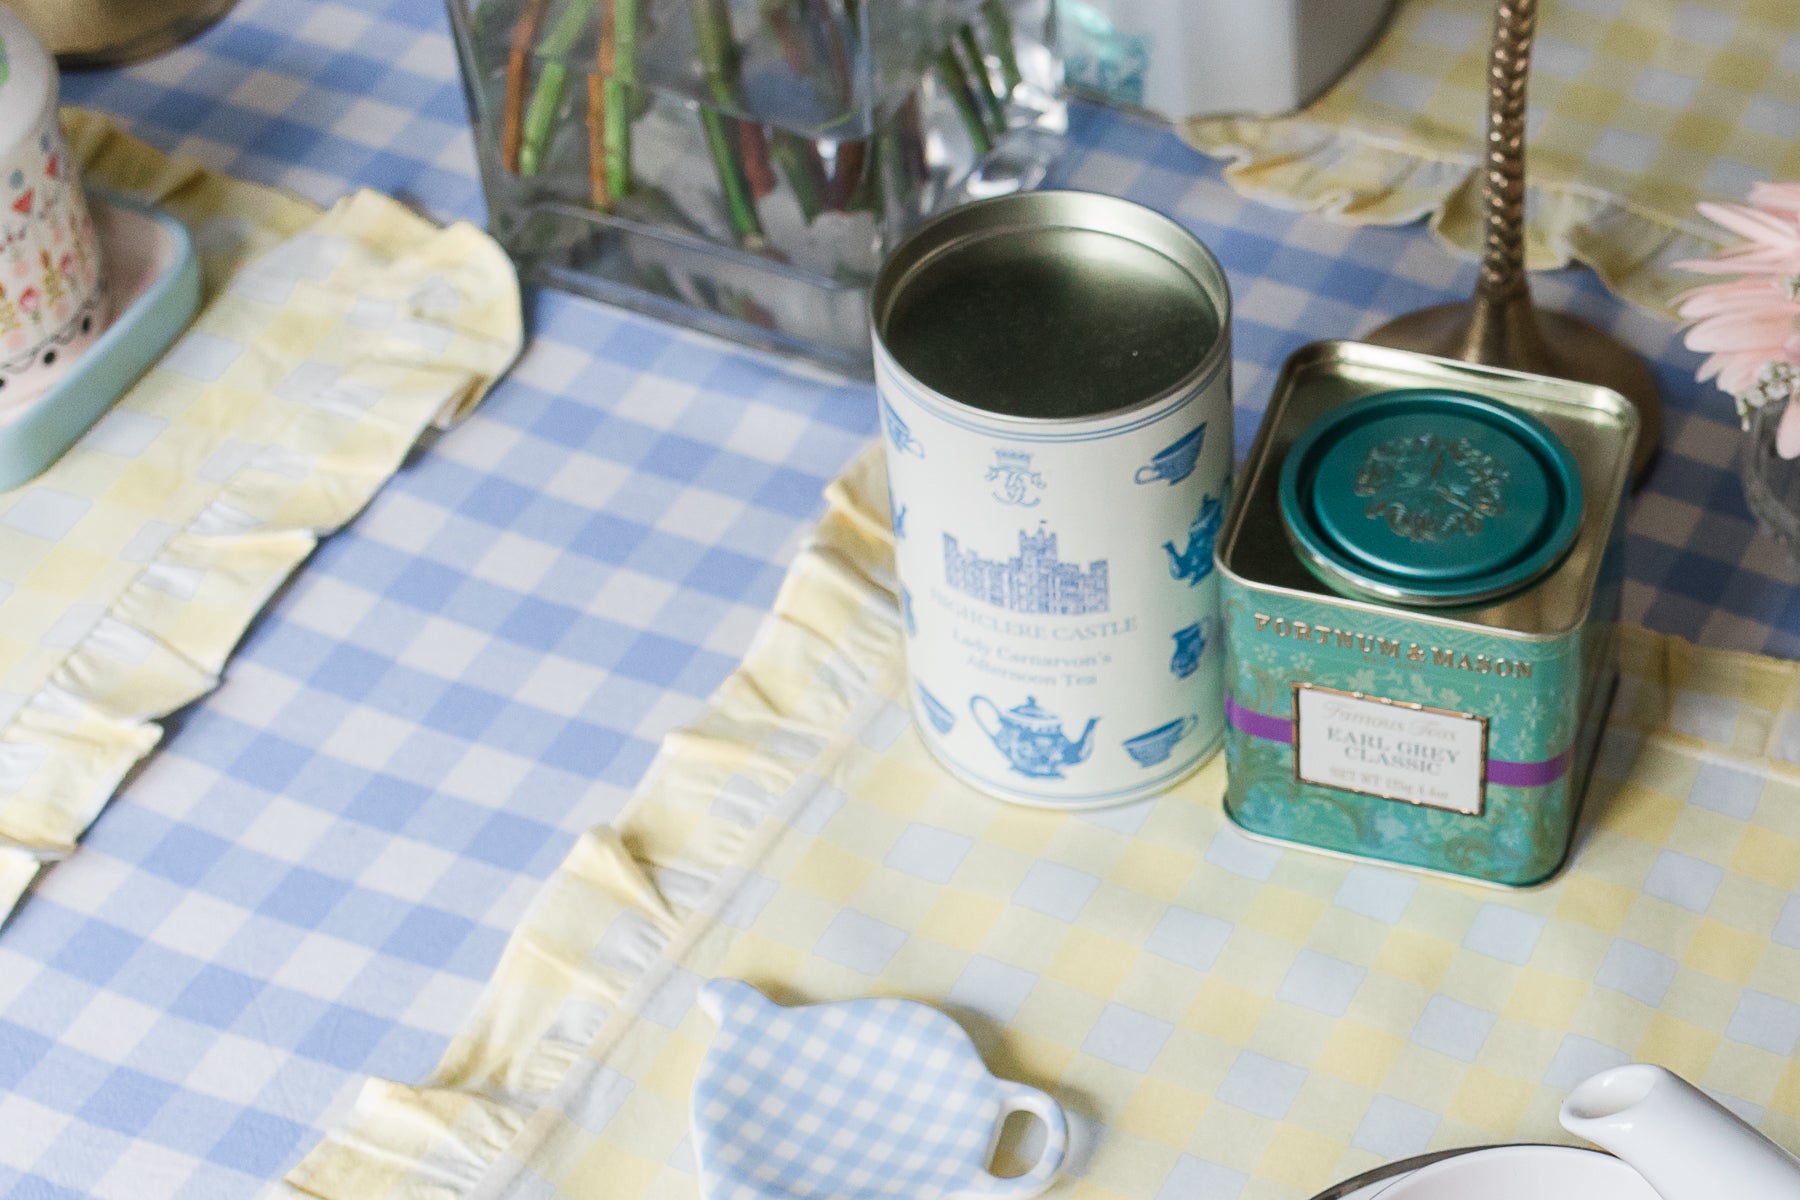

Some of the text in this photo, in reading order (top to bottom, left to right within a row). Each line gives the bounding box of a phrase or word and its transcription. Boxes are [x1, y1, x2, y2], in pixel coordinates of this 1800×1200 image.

[1053, 615, 1138, 641] CASTLE
[1254, 612, 1400, 659] FORTNUM
[1407, 642, 1425, 662] &
[1431, 646, 1533, 678] MASON
[1061, 673, 1099, 687] Tea
[1327, 726, 1461, 764] EARL GREY
[1343, 747, 1442, 775] CLASSIC
